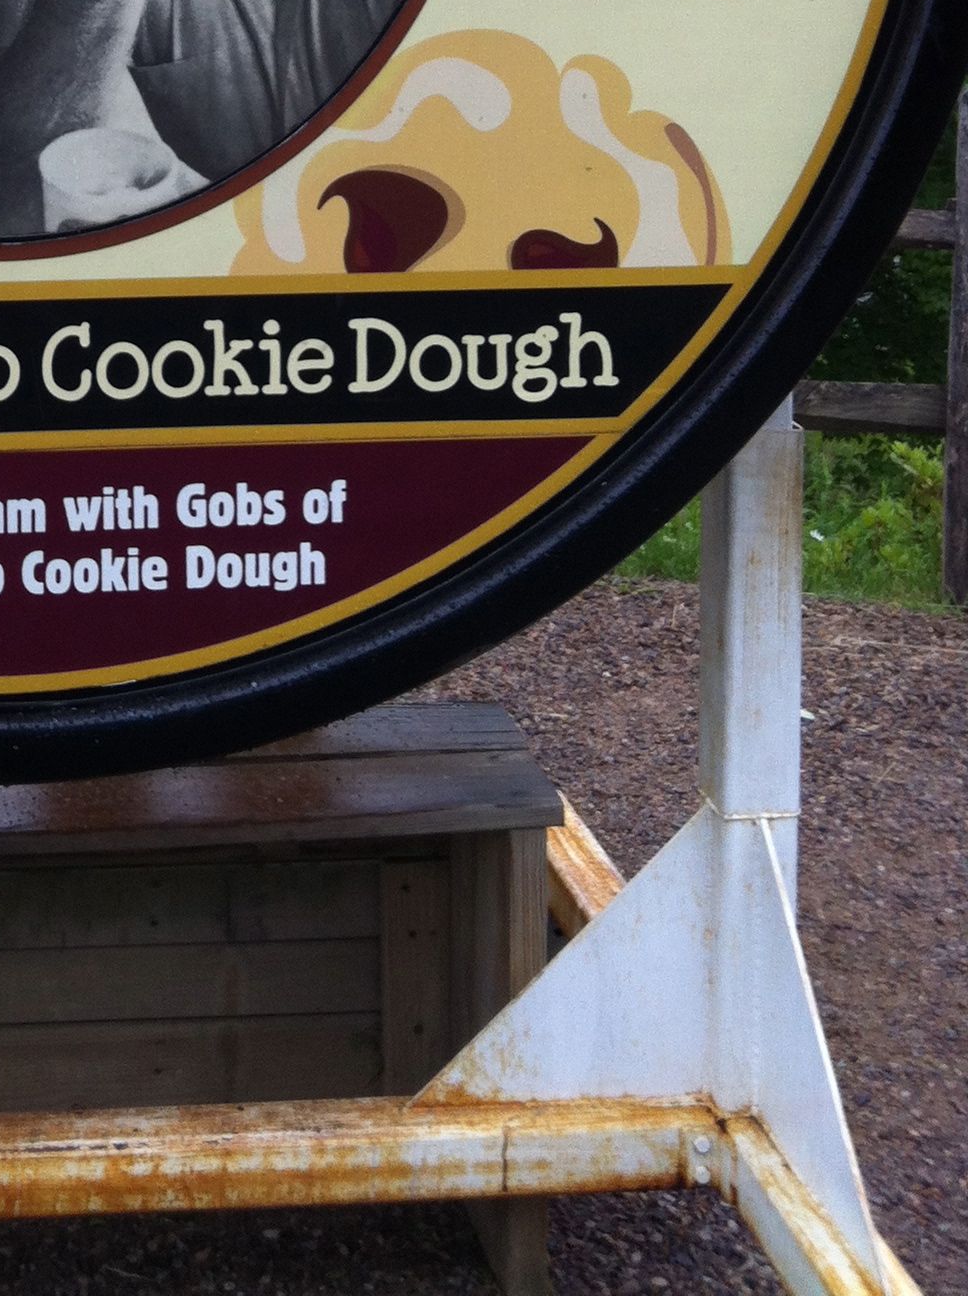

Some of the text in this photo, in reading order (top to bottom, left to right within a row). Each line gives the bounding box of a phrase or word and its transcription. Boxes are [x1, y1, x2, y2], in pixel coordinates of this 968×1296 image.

[41, 319, 335, 402] Cookie
[348, 312, 620, 403] Dough
[62, 485, 159, 532] with
[176, 482, 286, 528] Gobs
[302, 479, 347, 525] of
[21, 548, 168, 595] Cookie
[185, 541, 326, 592] Dough
